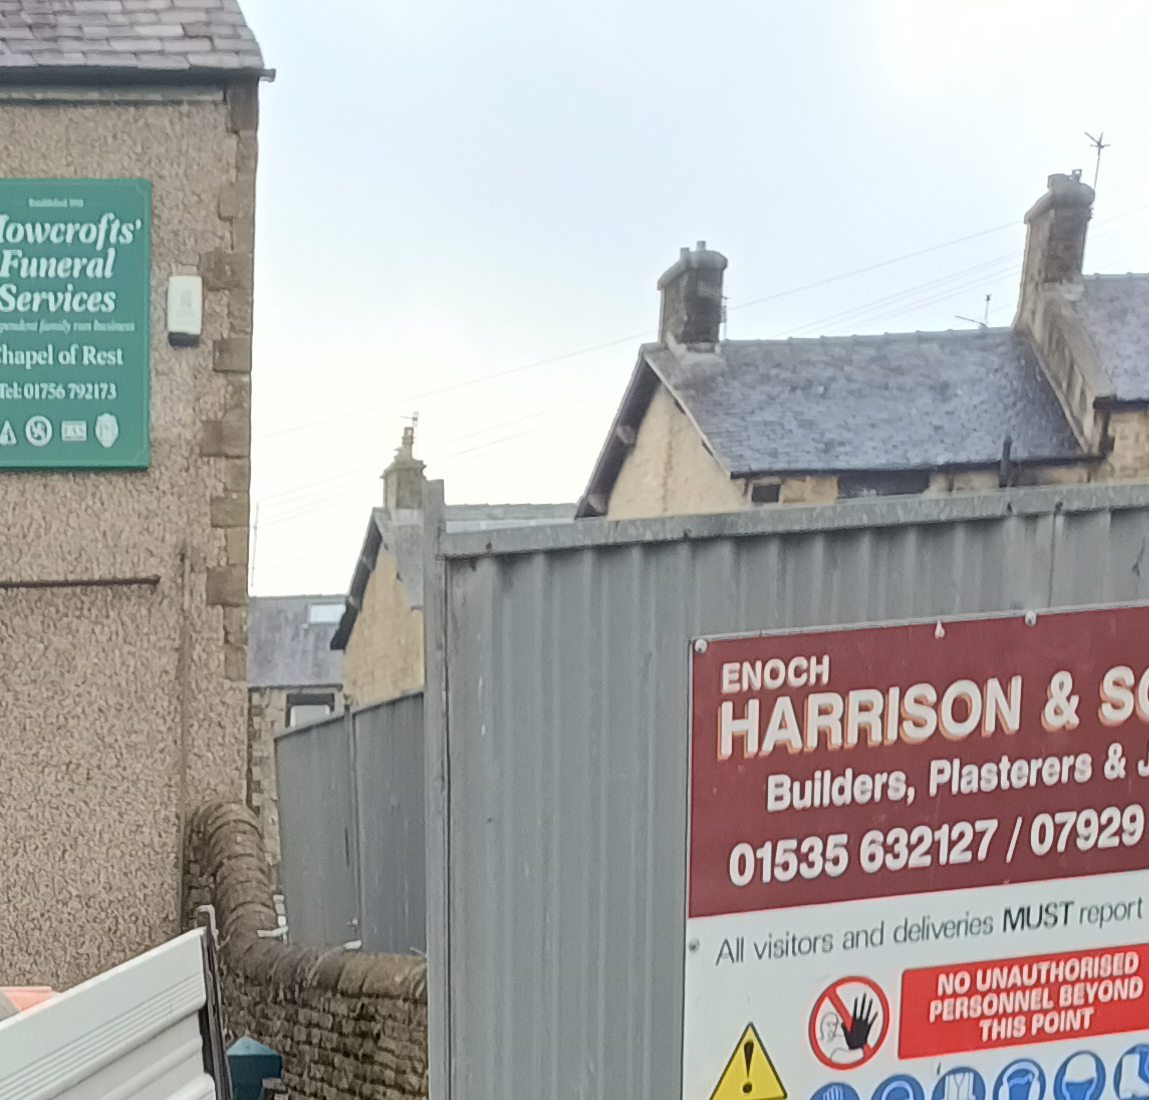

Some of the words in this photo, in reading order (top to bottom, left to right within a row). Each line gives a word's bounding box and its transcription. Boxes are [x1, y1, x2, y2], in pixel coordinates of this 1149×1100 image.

[58, 344, 79, 366] of
[82, 345, 124, 366] Rest
[23, 382, 66, 400] 01756
[68, 382, 117, 400] 792173
[721, 654, 830, 693] ENOCH
[717, 675, 1022, 761] HARRISON
[1041, 670, 1080, 732] &
[766, 767, 915, 812] Builders,
[929, 752, 1092, 797] Plasterers
[1103, 742, 1126, 780] &
[728, 833, 849, 886] 01535
[859, 818, 998, 874] 632127
[1006, 816, 1023, 863] /
[1030, 803, 1145, 857] 07929
[715, 937, 745, 966] All
[753, 929, 833, 961] visitors
[843, 920, 885, 950] and
[893, 912, 994, 944] deliveries
[1003, 901, 1075, 933] MUST
[1079, 897, 1143, 929] report
[937, 971, 971, 997] NO
[976, 951, 1140, 992] UNAUTHORISED
[929, 987, 1054, 1023] PERSONNEL
[1059, 976, 1144, 1008] BEYOND
[979, 1015, 1026, 1042] THIS
[1031, 1007, 1094, 1036] POINT
